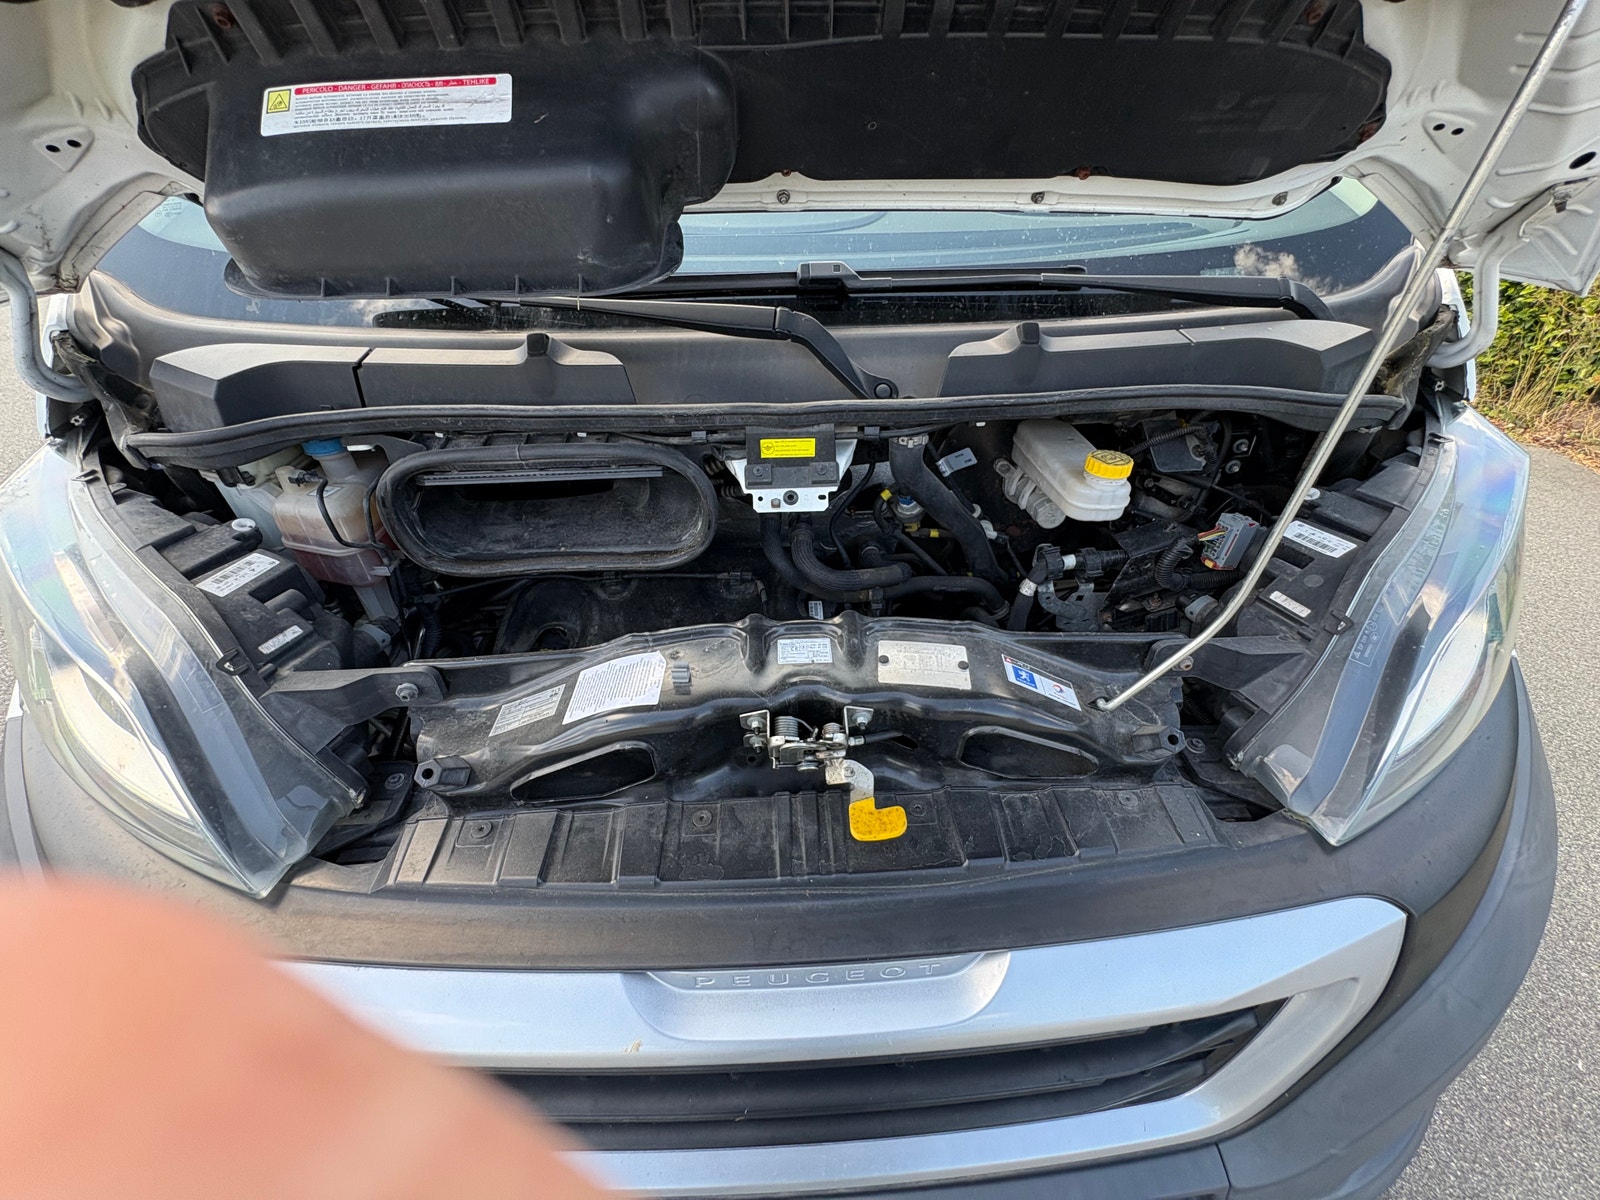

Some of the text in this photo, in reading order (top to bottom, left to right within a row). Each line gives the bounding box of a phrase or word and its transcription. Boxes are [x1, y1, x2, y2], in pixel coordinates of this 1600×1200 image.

[302, 82, 397, 94] PERICOLO DANGER GEFAHR
[695, 963, 941, 988] PEUGEOT
